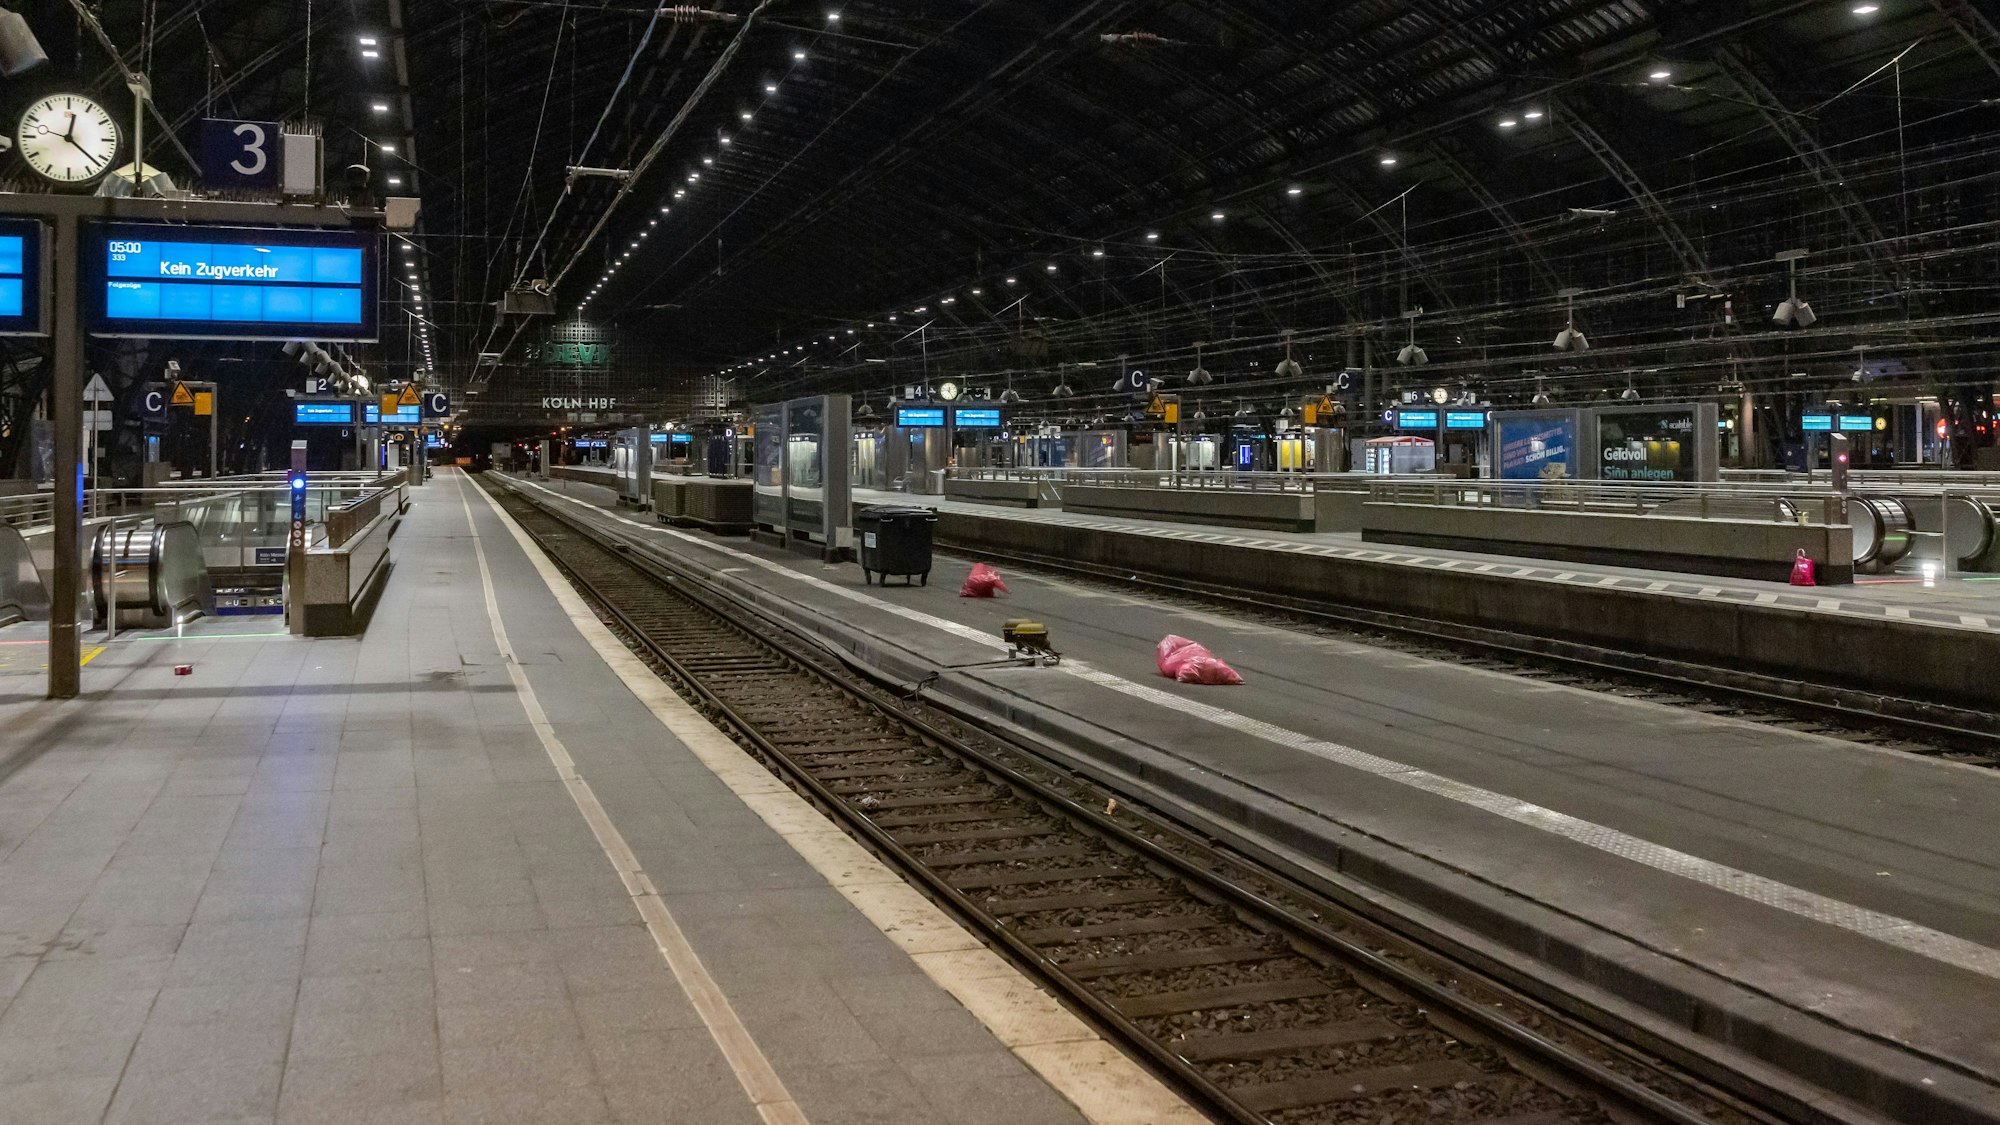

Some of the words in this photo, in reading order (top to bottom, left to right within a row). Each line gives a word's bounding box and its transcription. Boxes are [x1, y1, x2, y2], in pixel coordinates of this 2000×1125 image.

[230, 123, 267, 175] 3
[109, 241, 141, 254] 05:00
[112, 253, 126, 262] 333
[160, 261, 191, 276] Kein
[196, 262, 278, 280] Zugverkehr
[318, 378, 327, 391] 2
[1131, 370, 1143, 388] C
[1338, 372, 1350, 390] C
[915, 386, 922, 397] 4
[1411, 391, 1418, 401] 6
[146, 391, 162, 412] C
[431, 393, 447, 413] C
[542, 396, 582, 409] KÖLN
[589, 397, 617, 409] HBF
[1384, 410, 1393, 421] C
[342, 428, 349, 437] D
[437, 430, 444, 438] D
[725, 429, 732, 437] D
[1003, 431, 1009, 439] D
[1603, 447, 1647, 461] Geldvoll
[1631, 466, 1674, 480] anlegen
